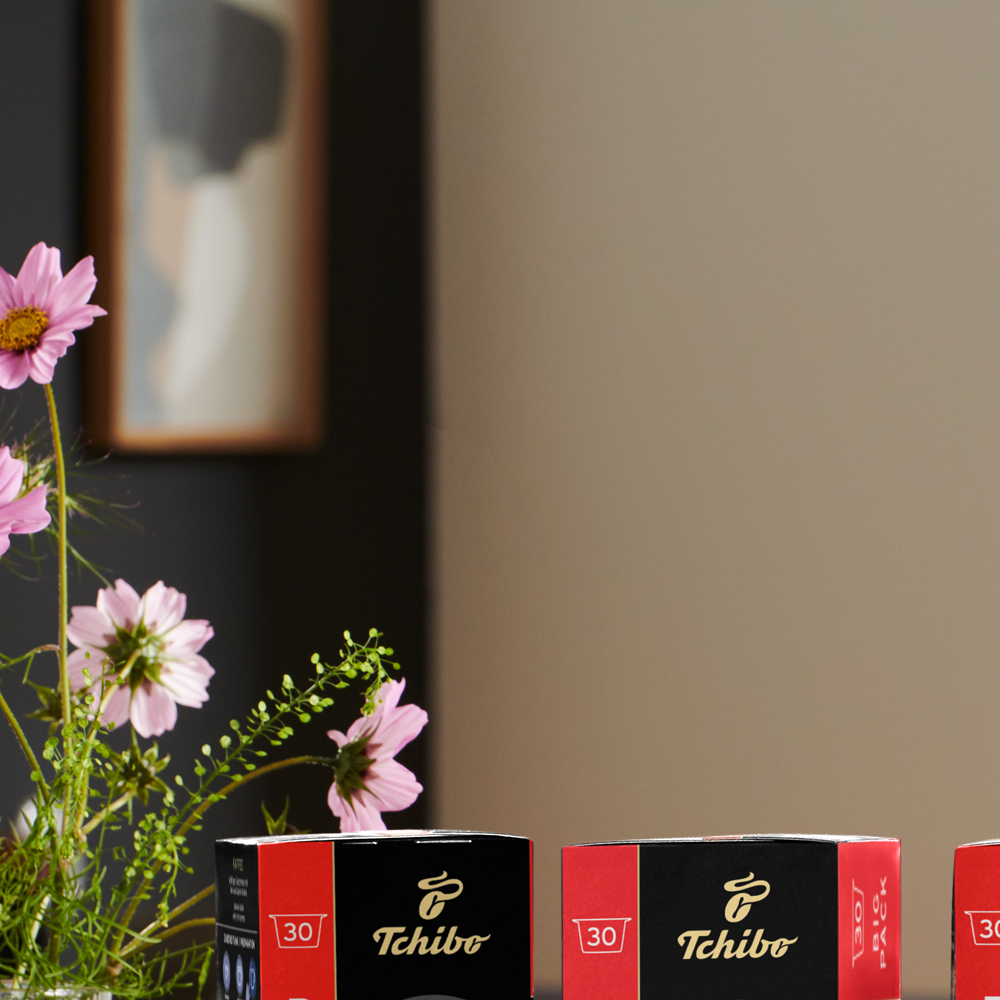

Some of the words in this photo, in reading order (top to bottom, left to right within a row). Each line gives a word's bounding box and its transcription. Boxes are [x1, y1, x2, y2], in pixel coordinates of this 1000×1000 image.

[283, 923, 313, 942] 30
[372, 926, 491, 955] Tchibo
[587, 927, 617, 946] 30
[677, 929, 798, 960] Tchibo
